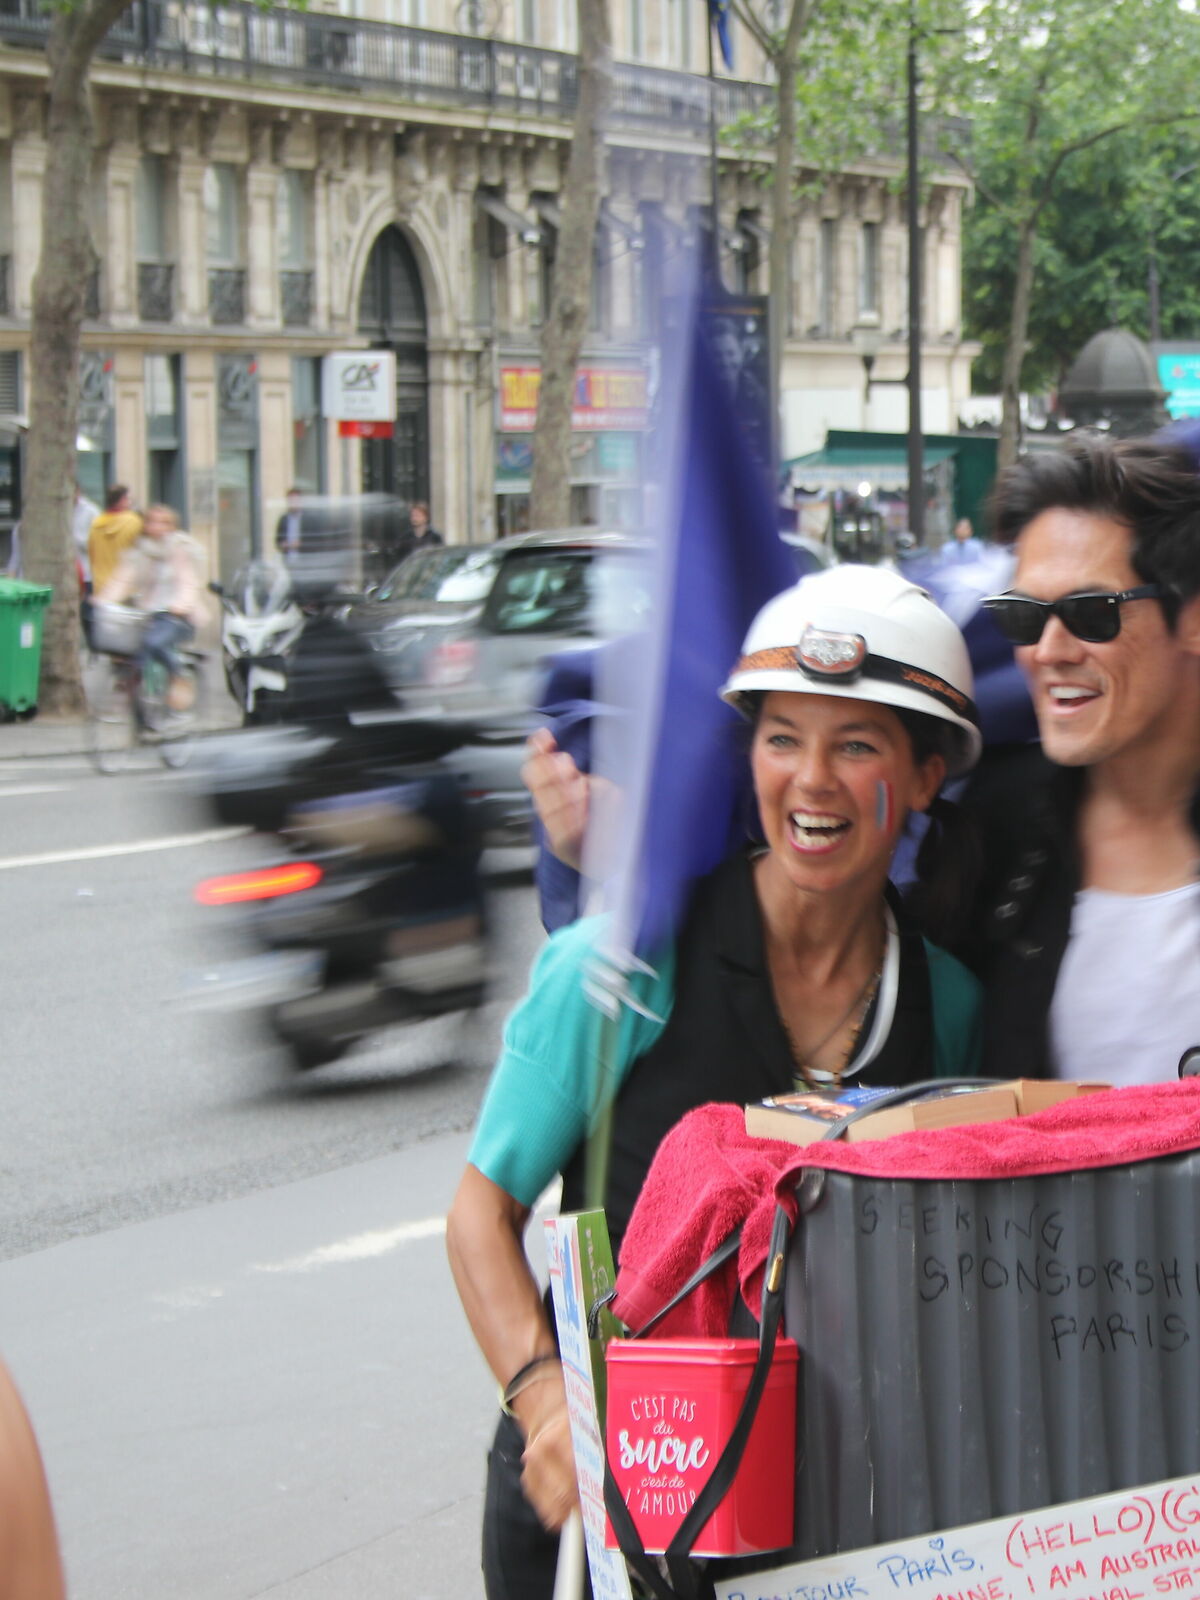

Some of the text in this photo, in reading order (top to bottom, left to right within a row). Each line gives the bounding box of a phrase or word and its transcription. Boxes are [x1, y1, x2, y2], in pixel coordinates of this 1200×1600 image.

[861, 1199, 1064, 1252] SEEKING
[1051, 1312, 1190, 1360] PARIS
[631, 1396, 697, 1423] C'EST PAS
[653, 1420, 675, 1435] du
[668, 1474, 686, 1489] de
[1050, 1559, 1088, 1590] AM
